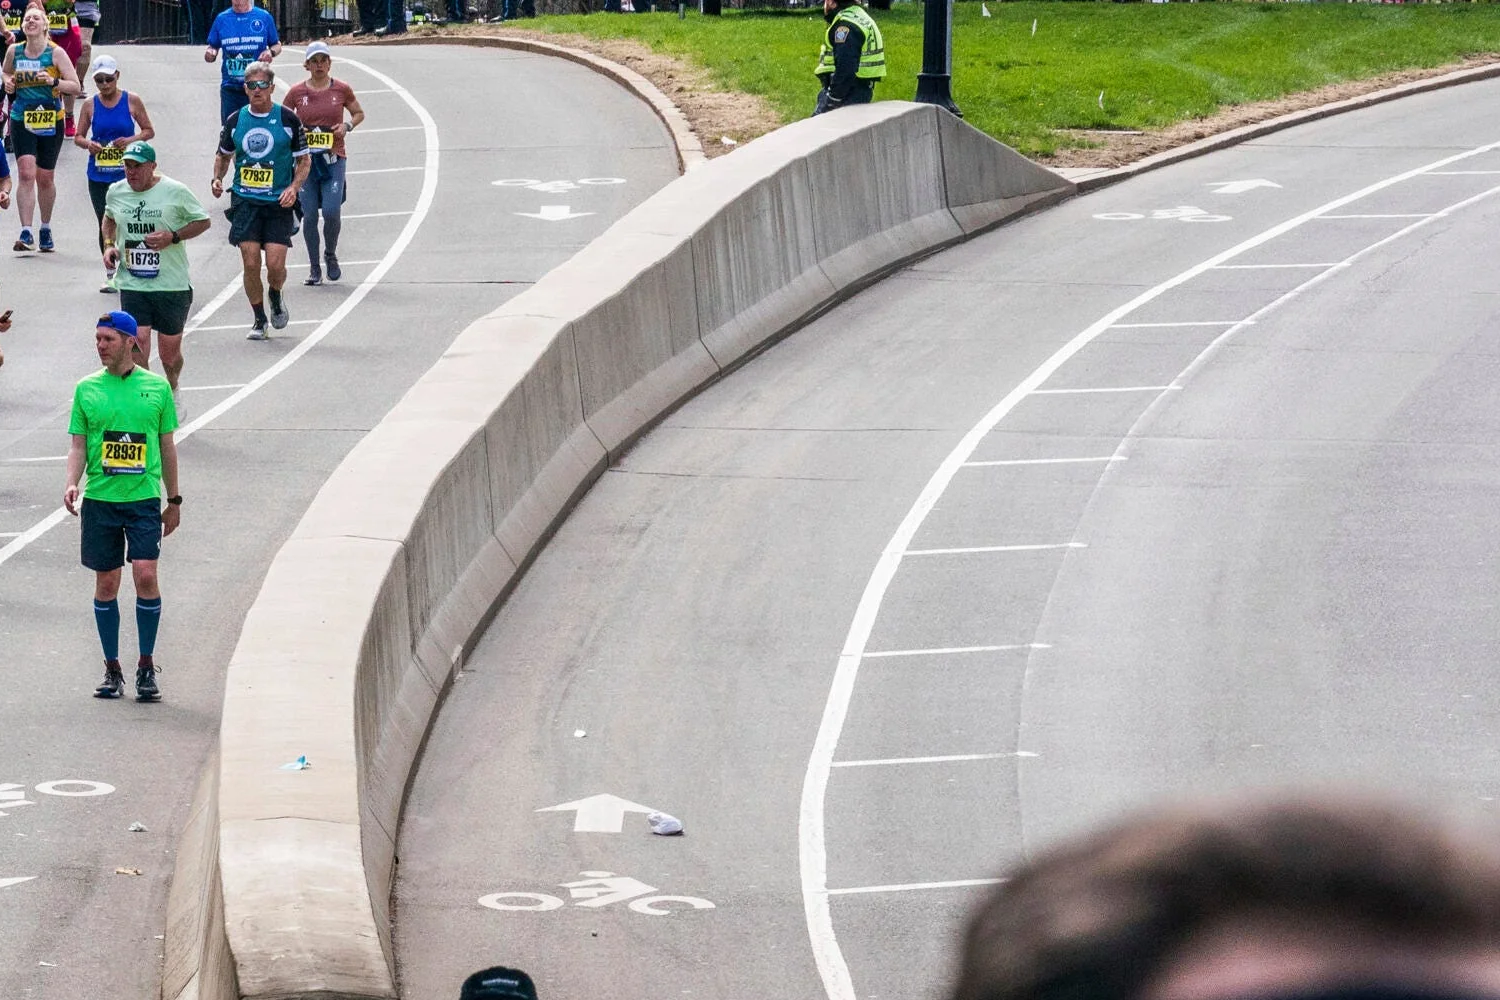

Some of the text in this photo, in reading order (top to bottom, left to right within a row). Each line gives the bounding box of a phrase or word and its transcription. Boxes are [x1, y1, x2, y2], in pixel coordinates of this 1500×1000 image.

[26, 112, 54, 123] 26732
[242, 169, 271, 182] 27937
[127, 222, 156, 235] BRIAN
[130, 251, 160, 266] 16733
[105, 443, 143, 461] 28931
